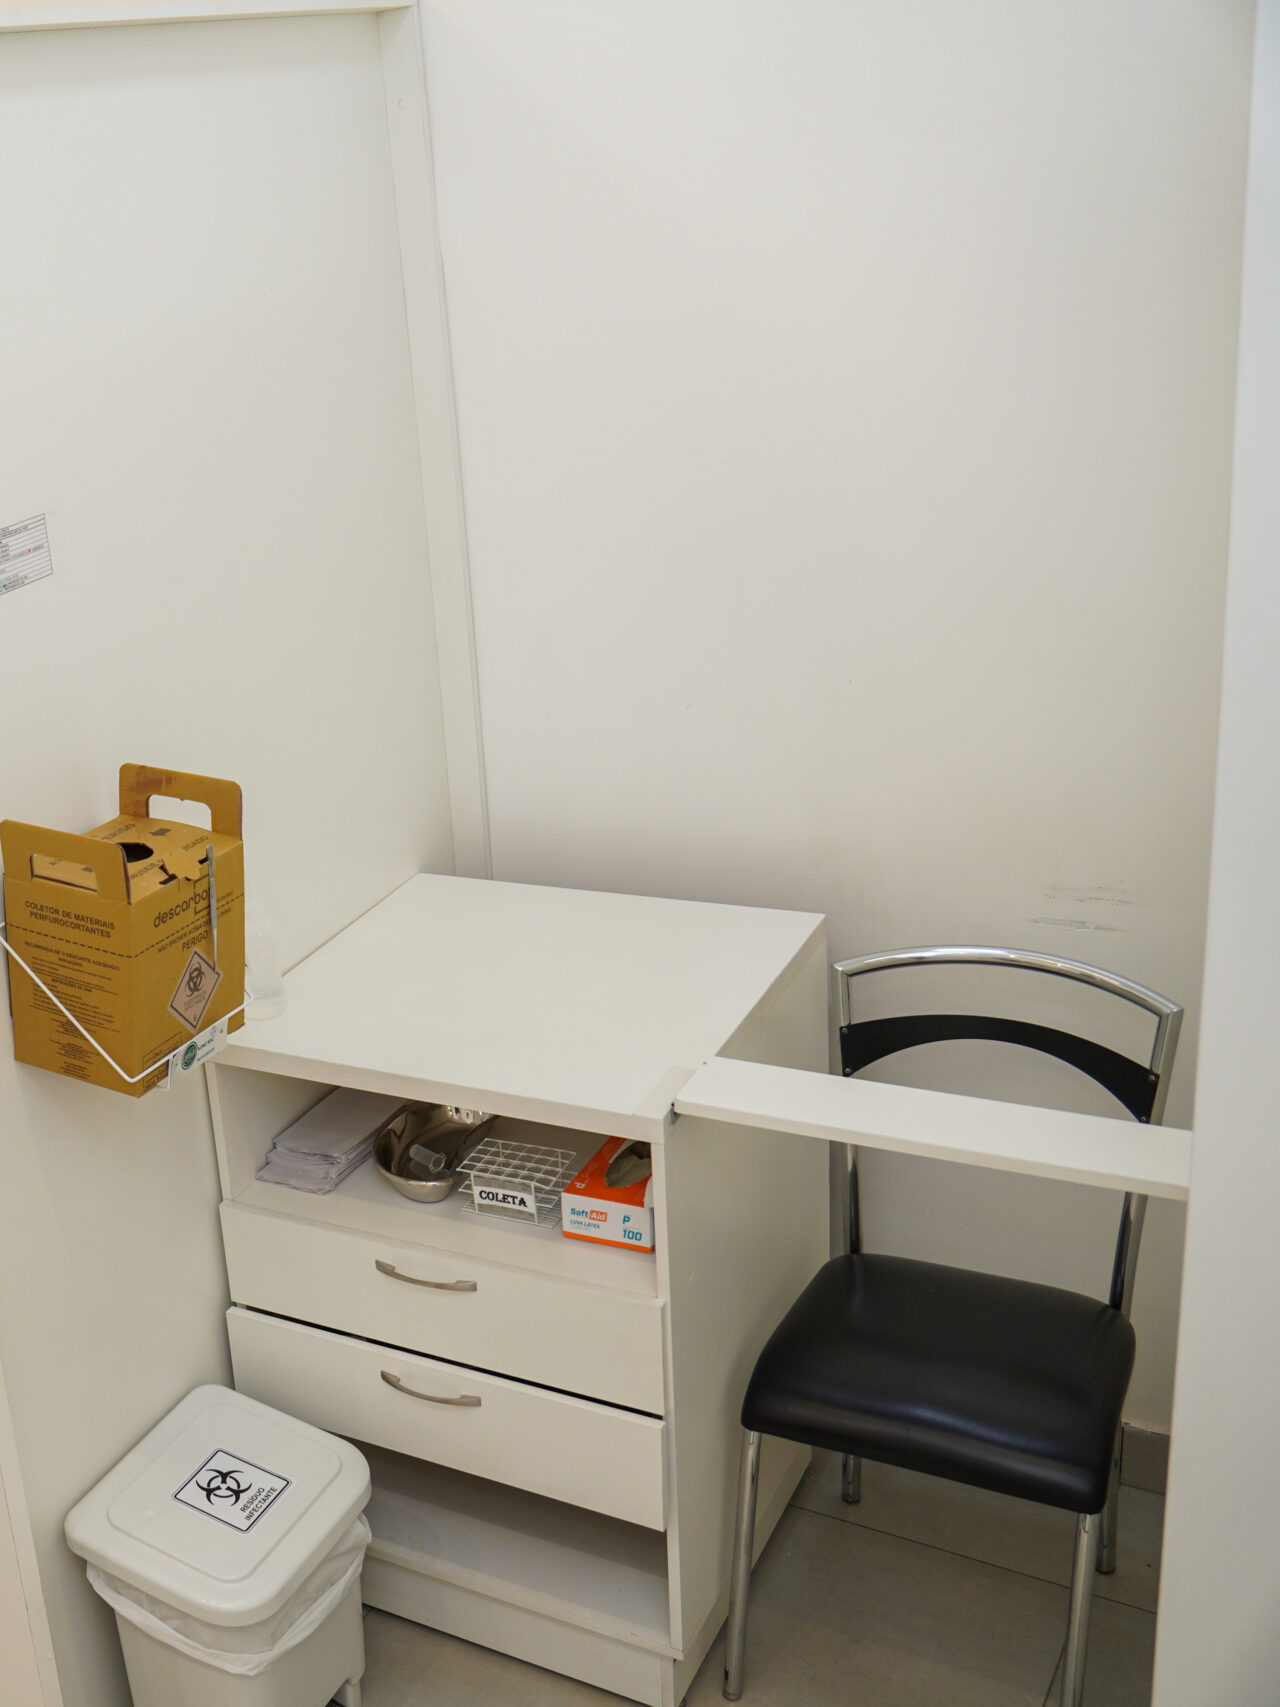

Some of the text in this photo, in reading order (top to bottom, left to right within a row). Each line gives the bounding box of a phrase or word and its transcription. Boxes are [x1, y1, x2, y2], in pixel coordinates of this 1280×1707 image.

[24, 900, 115, 930] COLETOR DE MATERIAIS
[153, 889, 210, 928] descarbo
[29, 911, 111, 938] PERFUROCORTANTES
[182, 930, 209, 952] PERIGO
[479, 1189, 528, 1208] COLETA
[570, 1207, 606, 1221] Soft Aid
[622, 1215, 631, 1224] P
[623, 1229, 643, 1242] 100
[240, 1487, 265, 1513] RESÍDUO
[244, 1486, 278, 1521] INFECTANTE
